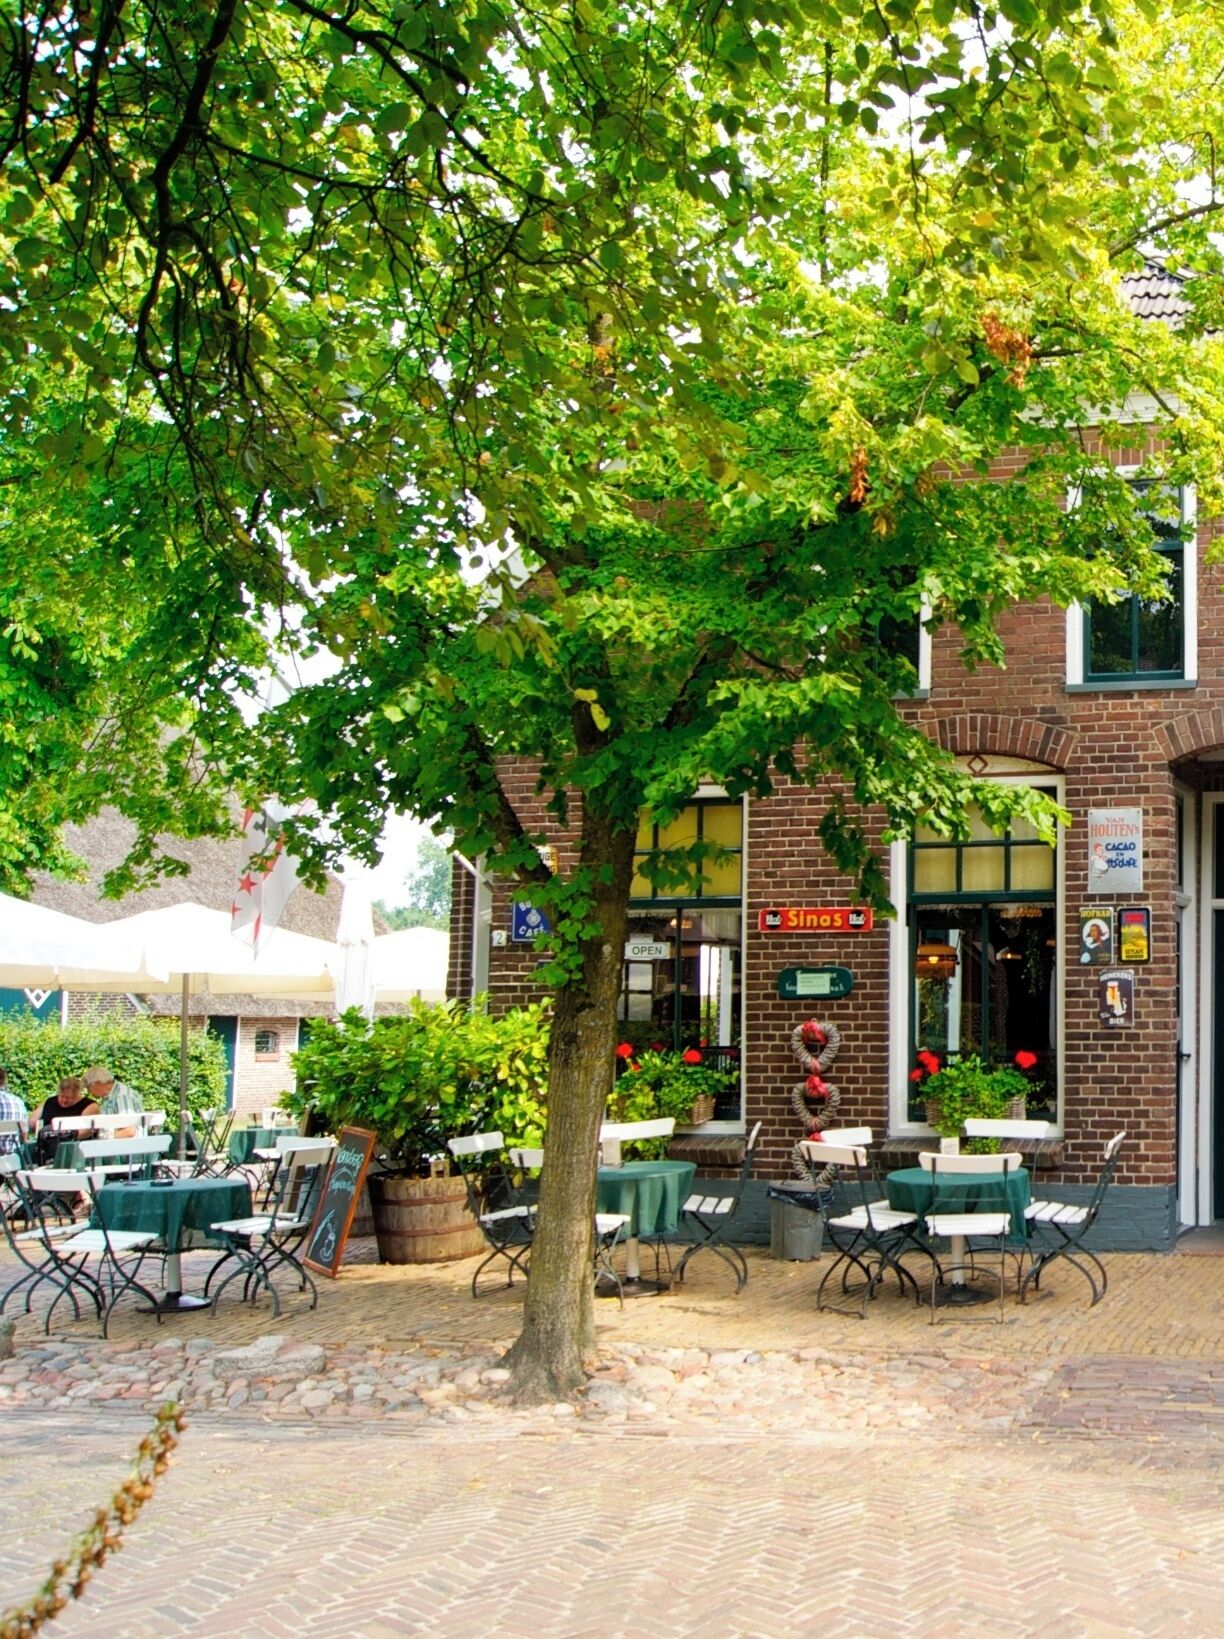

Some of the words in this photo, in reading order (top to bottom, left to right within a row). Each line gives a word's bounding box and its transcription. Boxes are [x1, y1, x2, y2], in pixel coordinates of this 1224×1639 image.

[1105, 842, 1137, 852] CACAO
[787, 910, 843, 927] Sinas
[632, 946, 662, 955] OPEN
